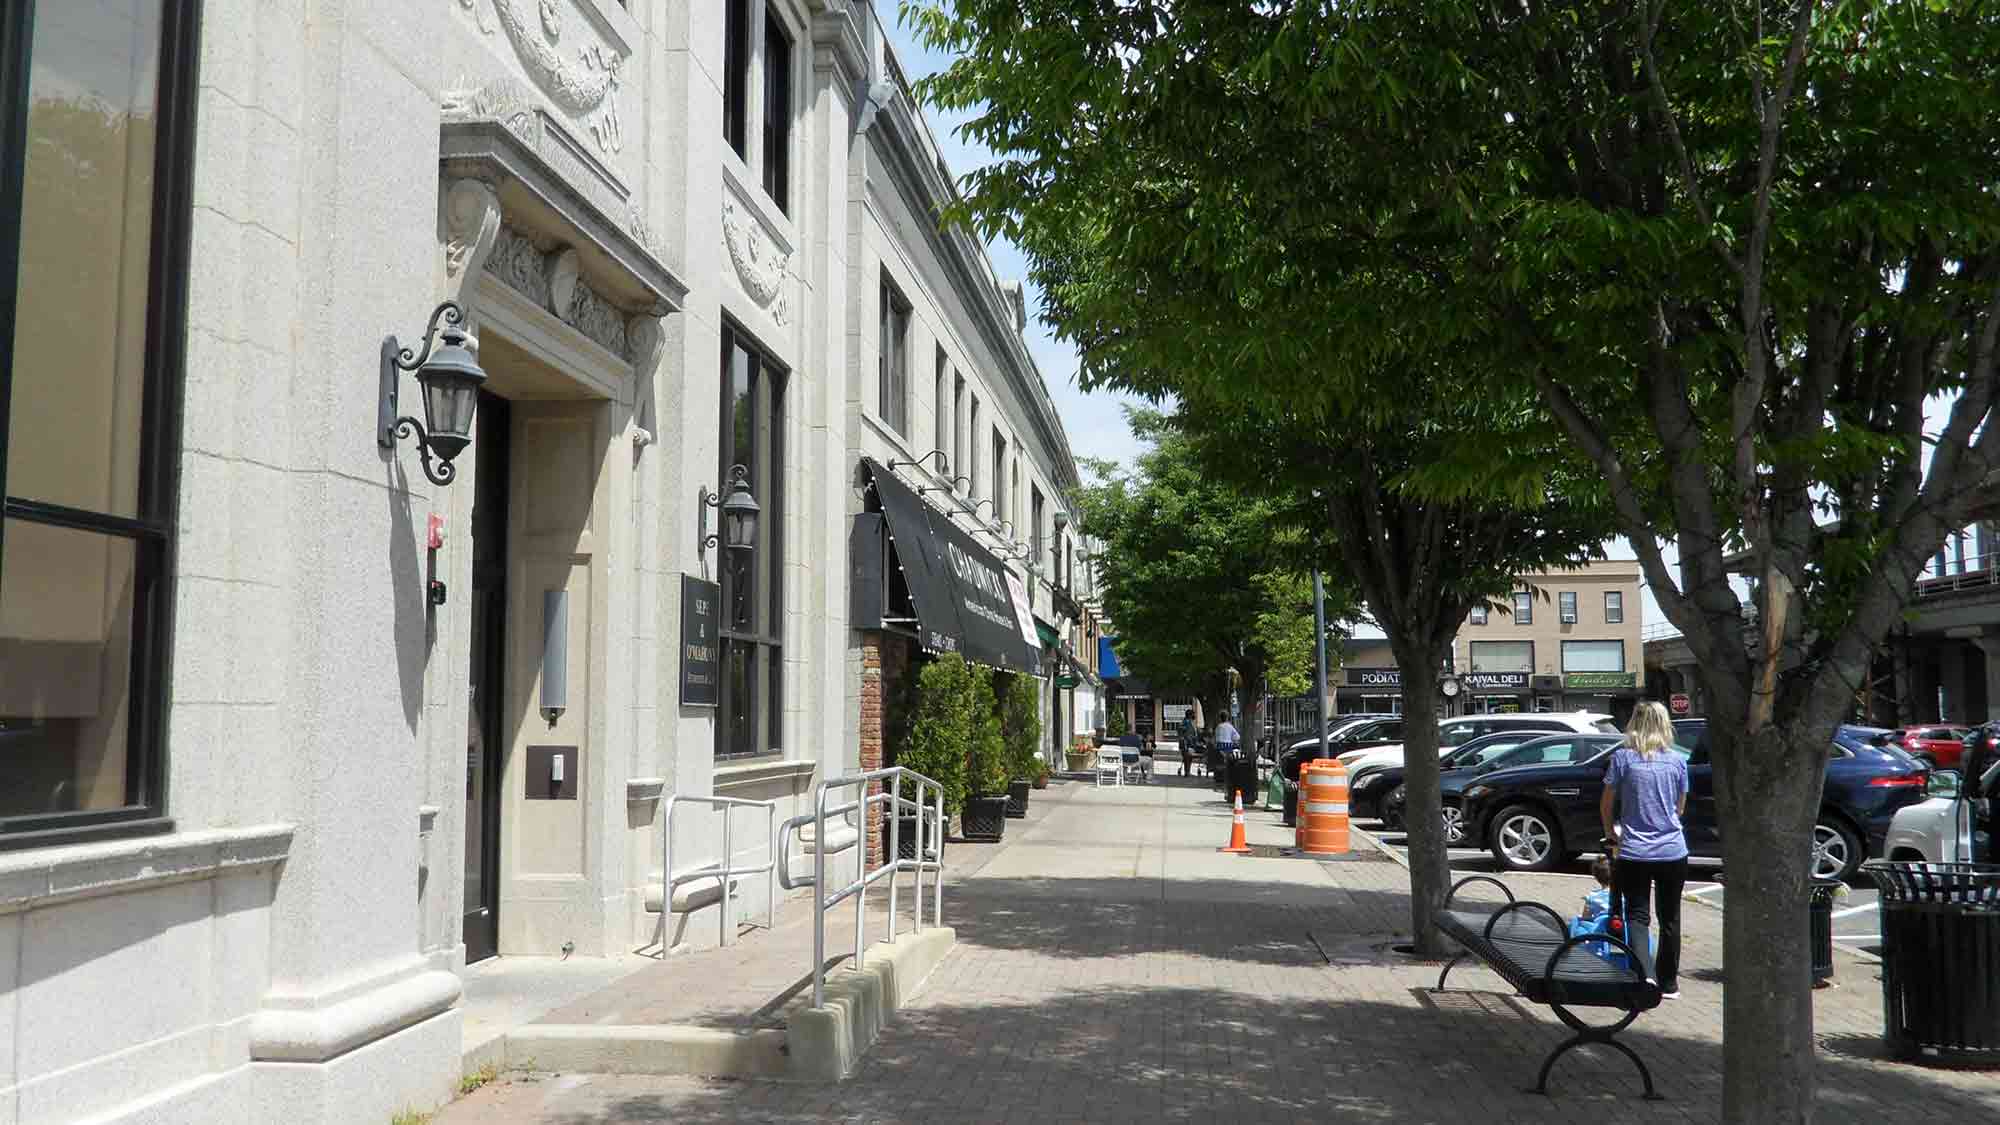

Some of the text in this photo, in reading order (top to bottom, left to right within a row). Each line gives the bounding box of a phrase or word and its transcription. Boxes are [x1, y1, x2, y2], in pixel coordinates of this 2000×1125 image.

[1361, 673, 1400, 684] PODIAT
[1465, 674, 1523, 684] KAIVAL DELI
